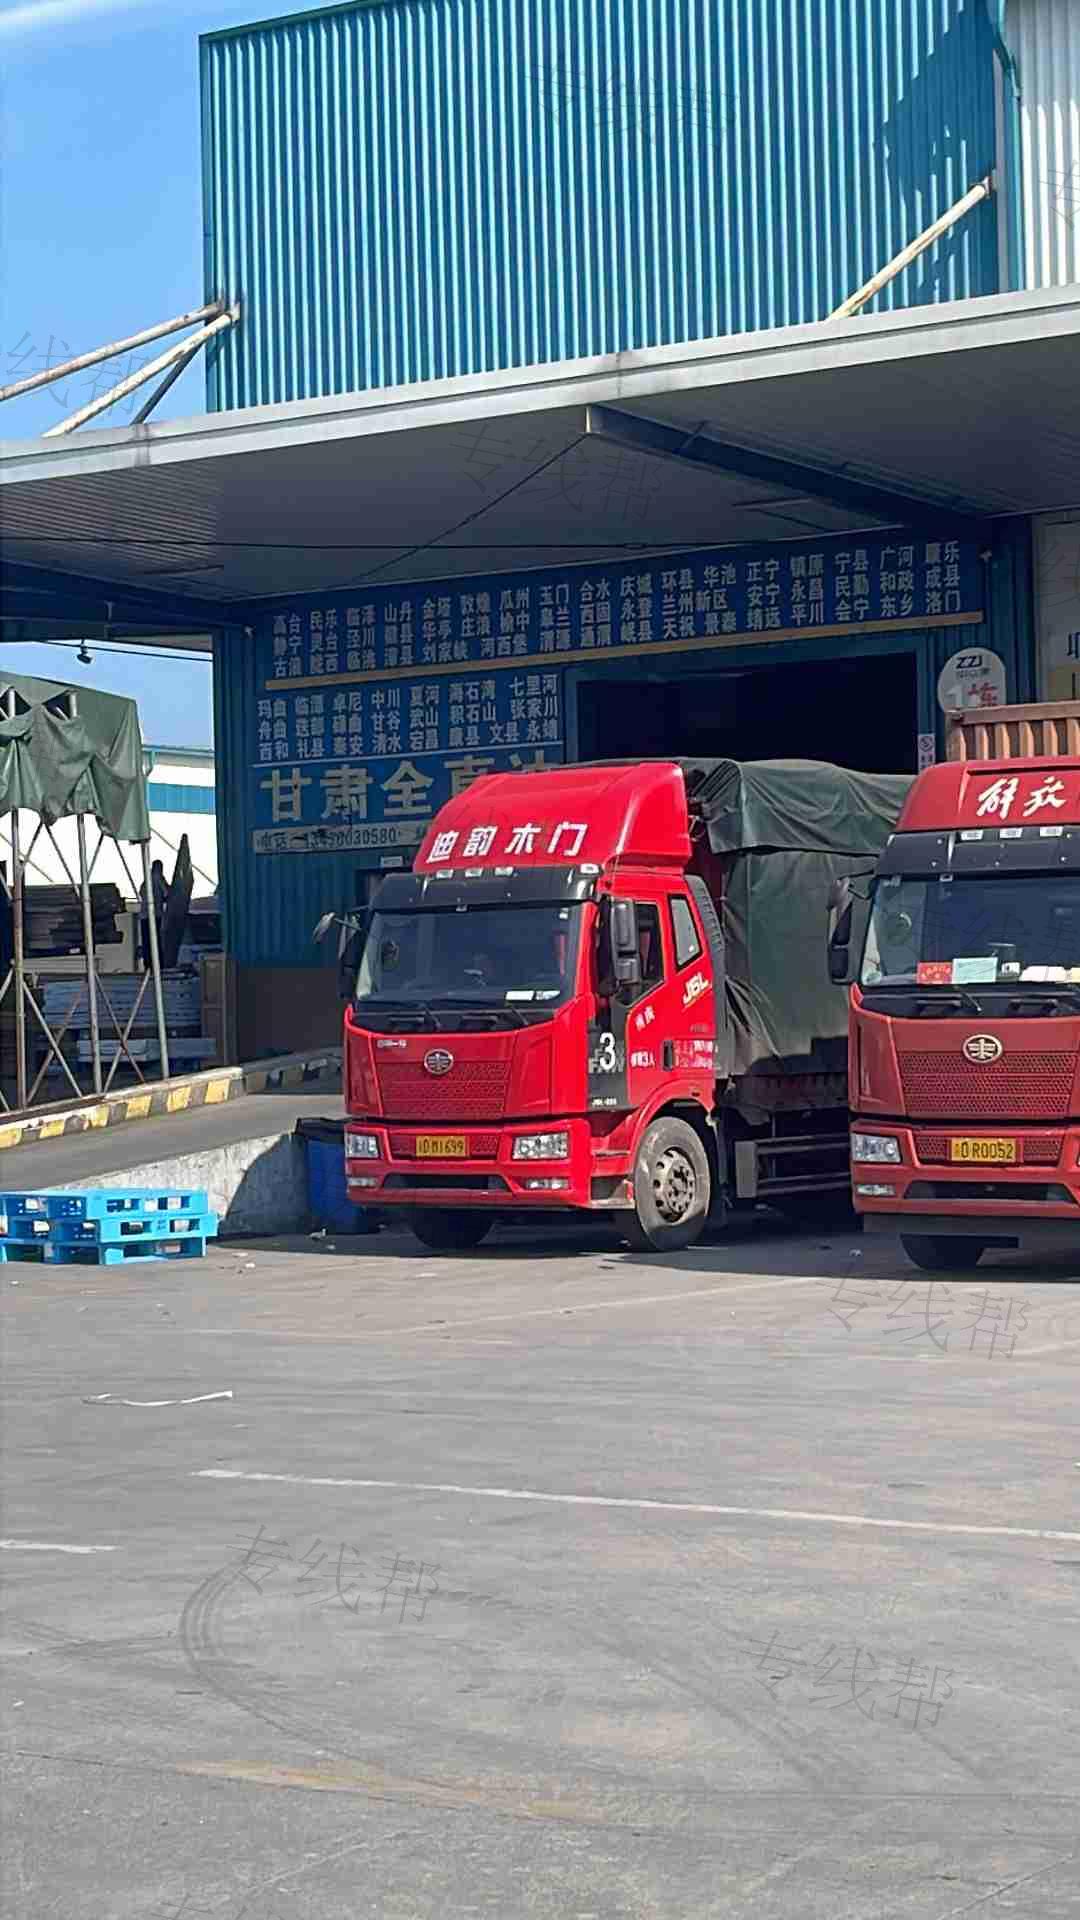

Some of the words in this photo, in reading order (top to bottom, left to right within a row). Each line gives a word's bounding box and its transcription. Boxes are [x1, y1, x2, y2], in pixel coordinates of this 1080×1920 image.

[384, 600, 414, 622] 山丹
[500, 587, 530, 610] 瓜州
[540, 584, 571, 606] 玉门
[580, 577, 611, 602] 合水
[661, 568, 693, 592] 环县
[704, 561, 736, 589] 华池
[745, 558, 780, 582] 正宁
[835, 549, 868, 573] 宁县
[880, 544, 914, 568] 广河
[580, 601, 611, 626] 西固
[621, 596, 652, 620] 永登
[662, 587, 729, 615] 兰州新区
[746, 582, 781, 607] 安宁
[790, 577, 824, 601] 永昌
[835, 572, 869, 597] 民勤
[880, 567, 914, 592] 和政
[926, 563, 961, 588] 成县
[662, 614, 696, 641] 天祝
[746, 605, 782, 632] 靖远
[790, 601, 824, 626] 平川
[835, 597, 870, 622] 会宁
[880, 591, 914, 617] 东乡
[926, 587, 961, 613] 洛门
[371, 687, 401, 710] 中川
[409, 683, 440, 705] 夏河
[508, 673, 558, 698] 七里河
[371, 709, 401, 732] 甘谷
[409, 704, 440, 729] 武山
[449, 700, 497, 724] 积石山
[511, 695, 558, 720] 张家川
[296, 735, 325, 759] 礼县
[372, 730, 402, 754] 清水
[409, 726, 440, 752] 宕昌
[489, 718, 520, 744] 文县
[527, 716, 558, 742] 永靖
[426, 822, 588, 864] 迪韵木门
[600, 1032, 616, 1070] 3
